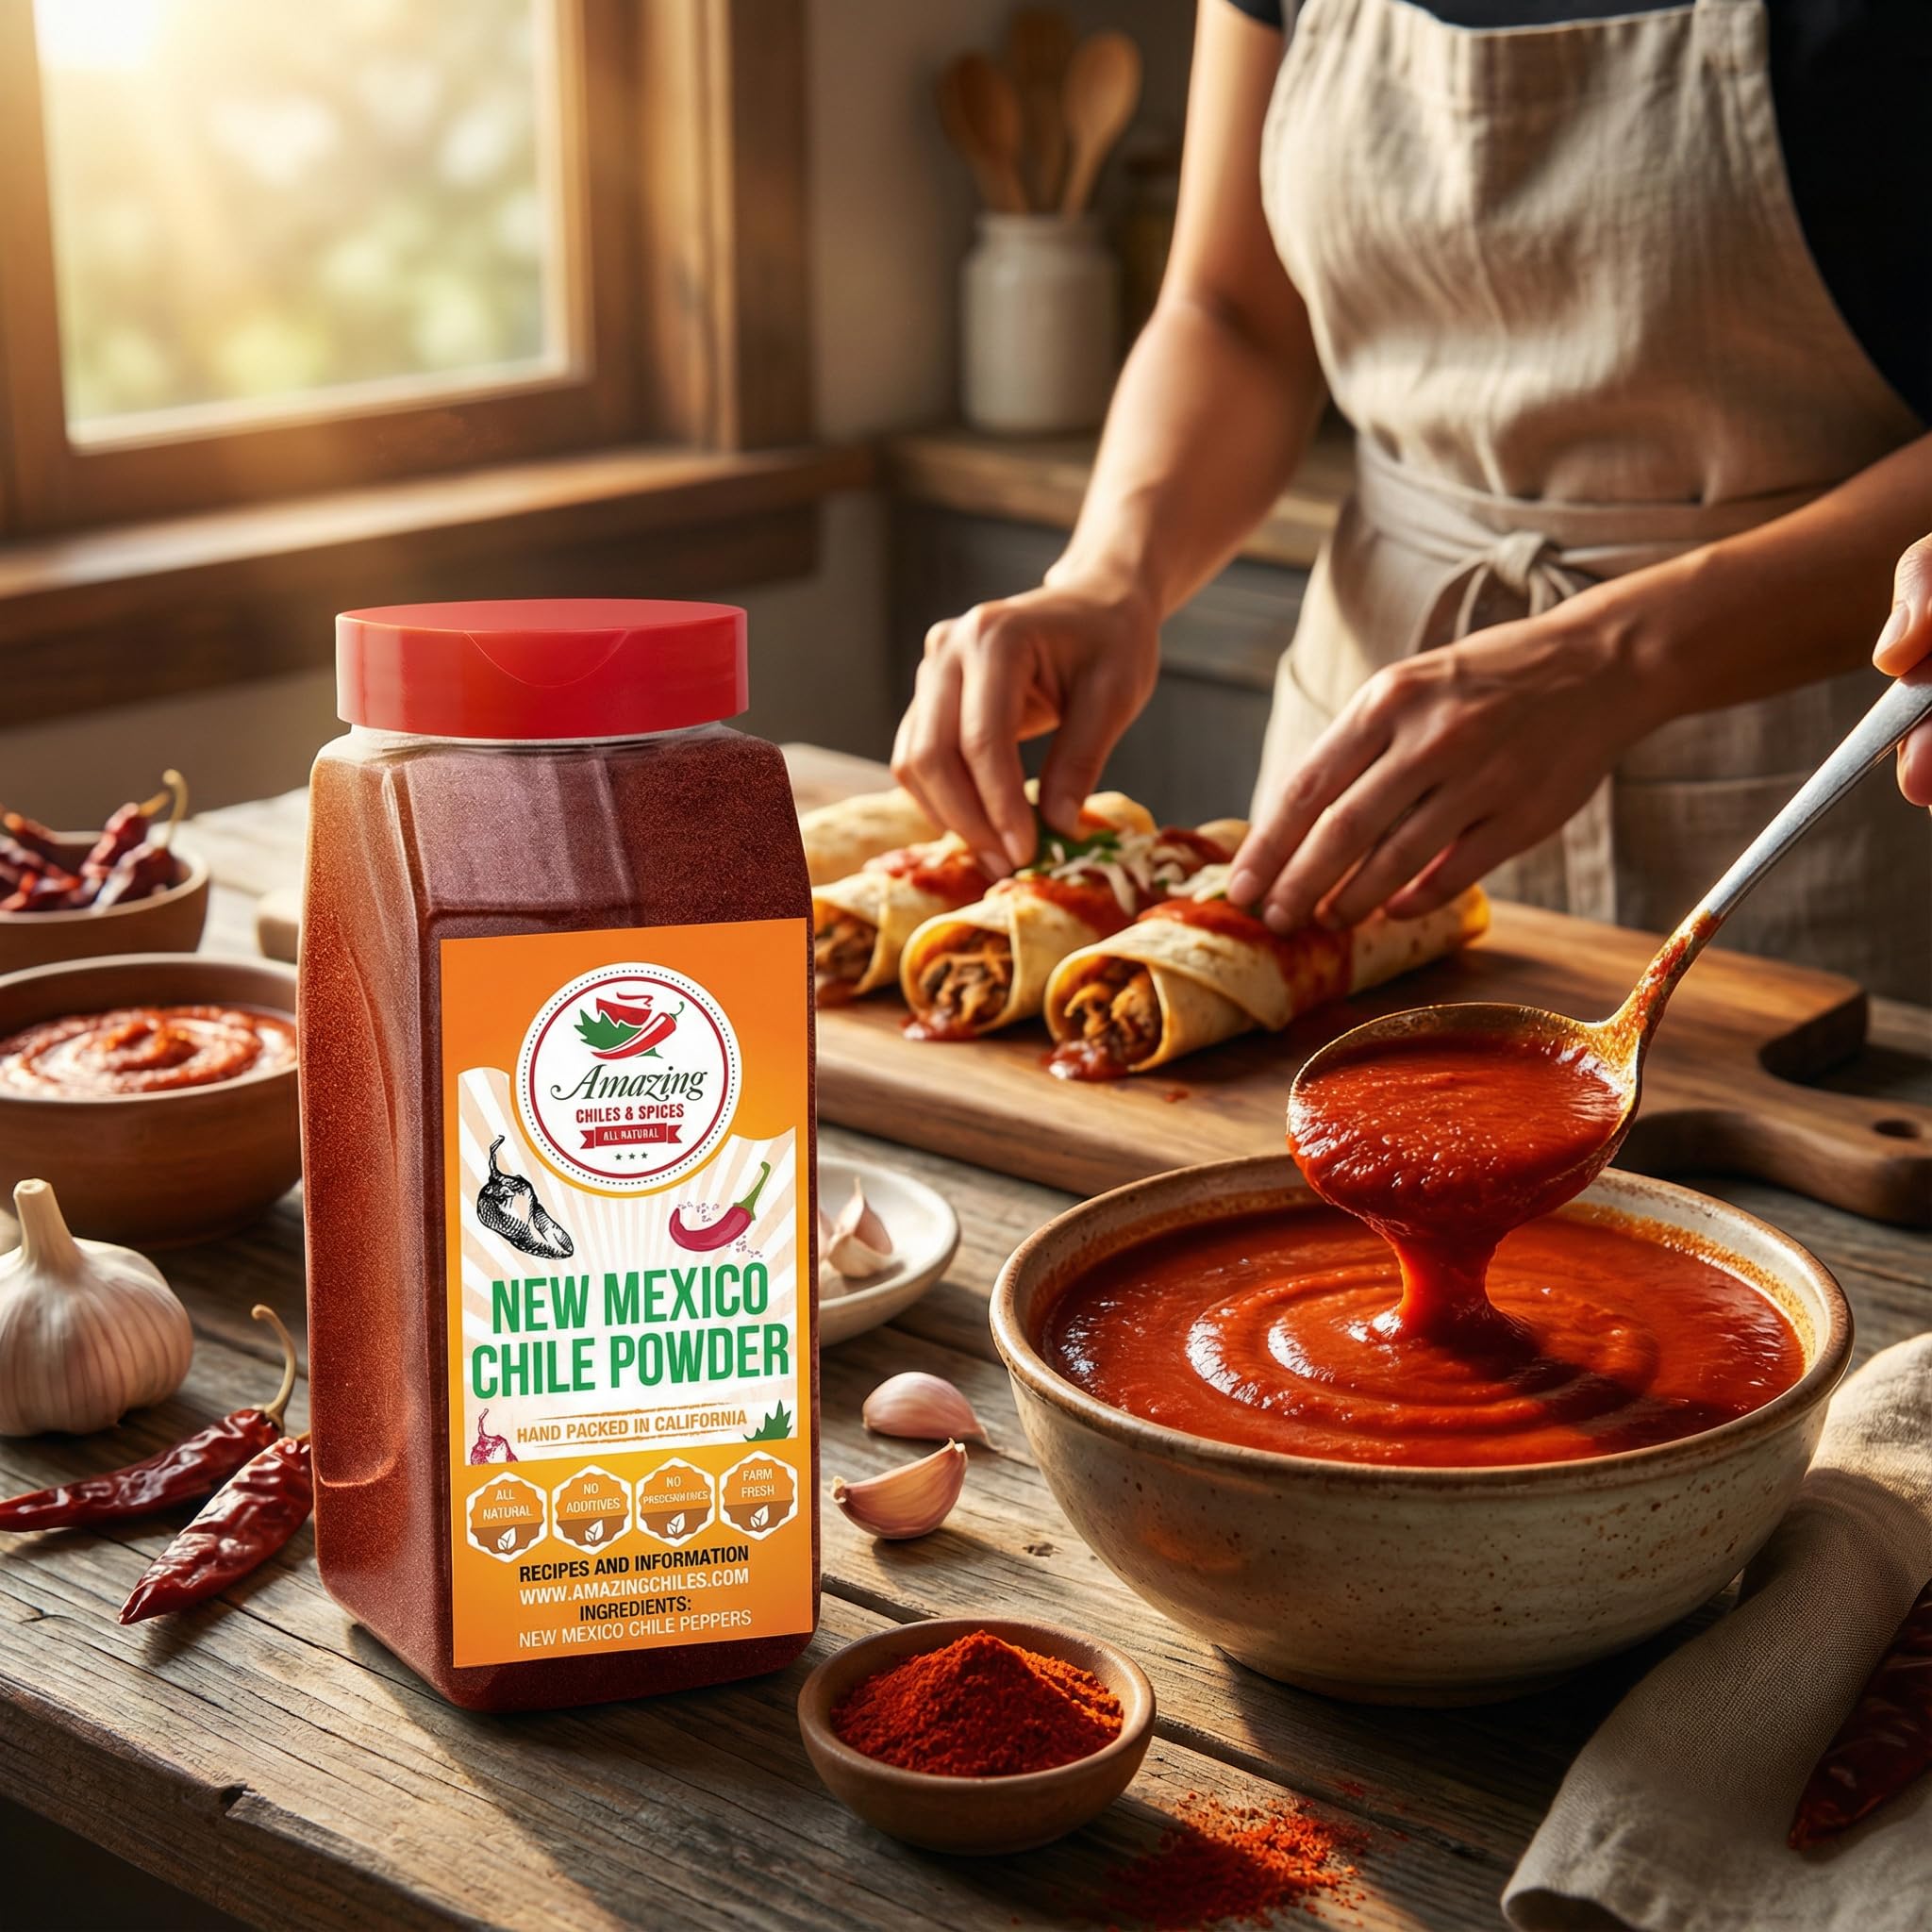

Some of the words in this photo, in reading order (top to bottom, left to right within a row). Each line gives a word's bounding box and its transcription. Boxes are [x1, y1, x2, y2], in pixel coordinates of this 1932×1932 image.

[550, 1064, 708, 1102] Amazing
[575, 1107, 621, 1124] CHILES
[625, 1106, 634, 1120] &
[639, 1104, 684, 1119] SPICES
[603, 1130, 619, 1141] ALL
[492, 1275, 590, 1334] NEW
[604, 1262, 768, 1325] MEXICO
[472, 1338, 595, 1398] CHILE
[610, 1324, 789, 1388] POWDER
[517, 1426, 561, 1443] HAND
[566, 1421, 626, 1440] PACKED
[634, 1419, 649, 1434] IN
[655, 1410, 747, 1433] CALIFORNIA
[666, 1476, 681, 1489] NO
[742, 1469, 773, 1481] FARM
[495, 1489, 514, 1501] ALL
[583, 1483, 599, 1495] NO
[741, 1484, 774, 1498] FRESH
[483, 1505, 533, 1520] NATURAL
[566, 1498, 621, 1513] ADDITIVES
[520, 1561, 590, 1582] RECIPES
[594, 1557, 629, 1575] AND
[635, 1545, 749, 1572] INFORMATION
[520, 1568, 749, 1606] WWW.AMAZINGCHILES.COM
[579, 1596, 691, 1622] INGREDIENTS:
[519, 1631, 558, 1648] NEW
[561, 1623, 624, 1644] MEXICO
[628, 1618, 675, 1638] CHILE
[680, 1609, 752, 1632] PEPPERS
